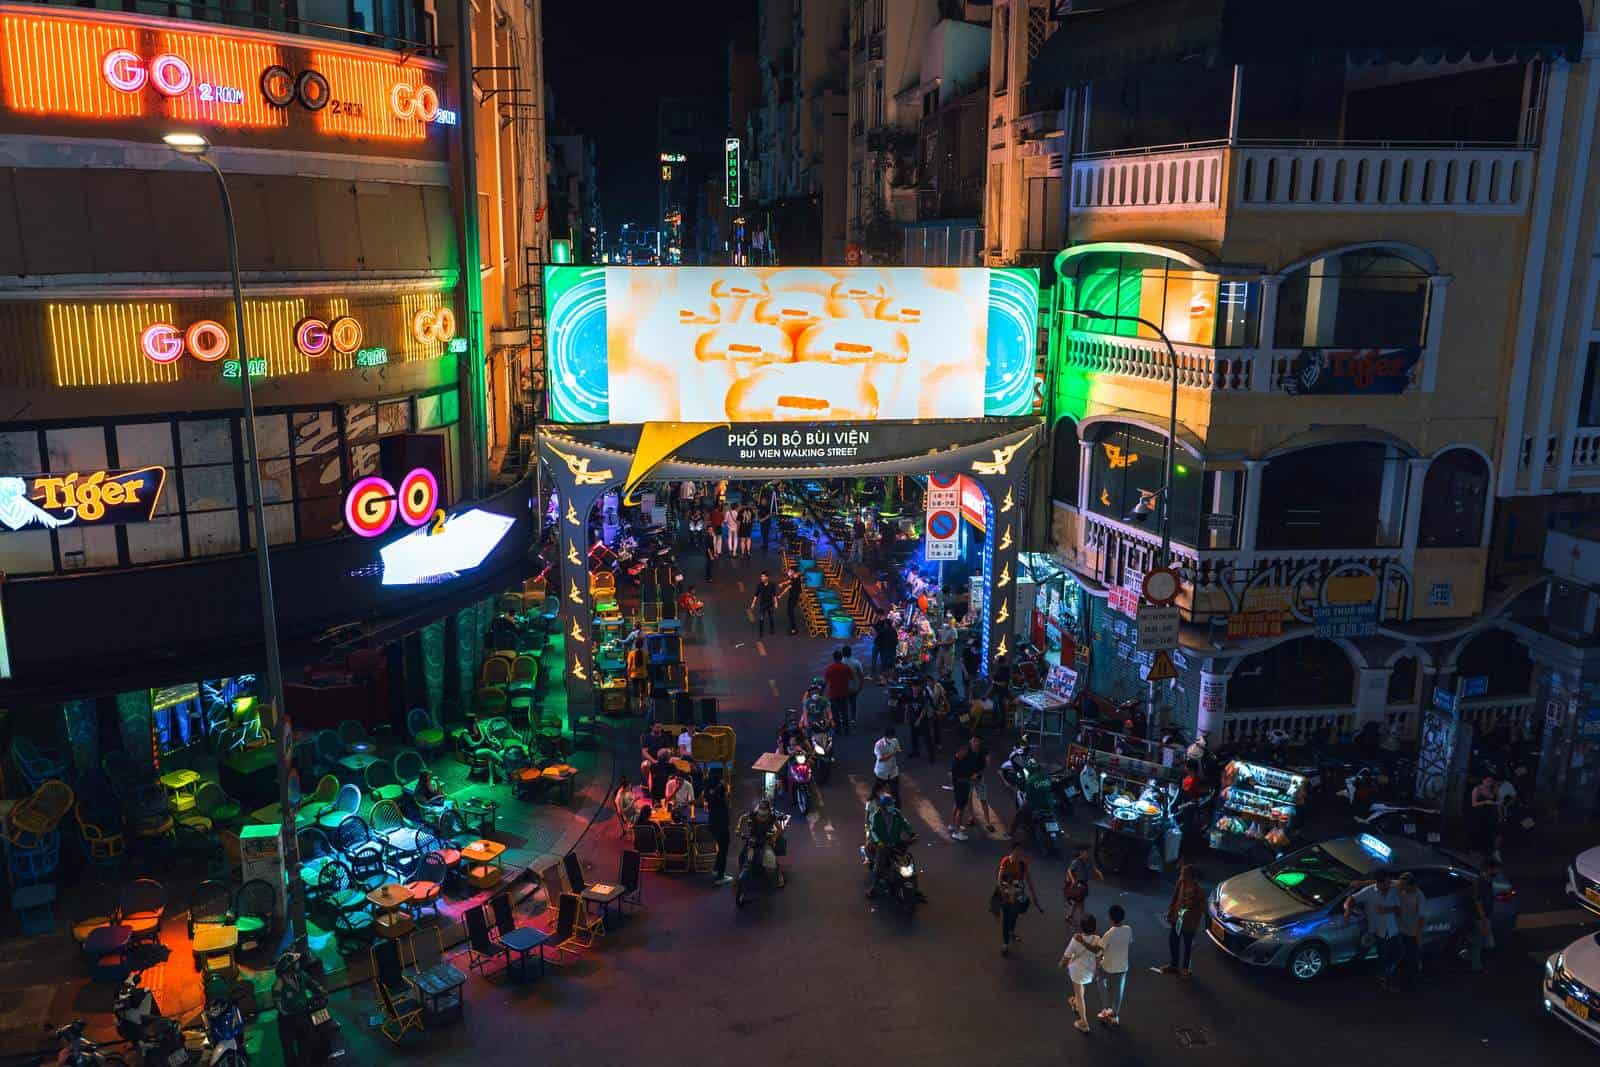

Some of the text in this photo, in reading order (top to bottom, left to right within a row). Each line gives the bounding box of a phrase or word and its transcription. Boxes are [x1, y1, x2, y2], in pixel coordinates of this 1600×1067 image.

[103, 48, 193, 96] GO
[198, 83, 213, 101] 2
[261, 65, 330, 111] GO
[331, 101, 341, 114] 2
[391, 82, 438, 121] GO
[141, 320, 230, 364] GO
[223, 359, 237, 377] 2
[296, 317, 362, 358] GO
[414, 307, 456, 345] GO
[728, 428, 869, 448] PHỐ ĐI BỘ BÙI VIỆN
[740, 447, 858, 458] BUI VIEN WALKING STREET
[33, 471, 144, 521] Tiger
[345, 467, 446, 538] GO 2
